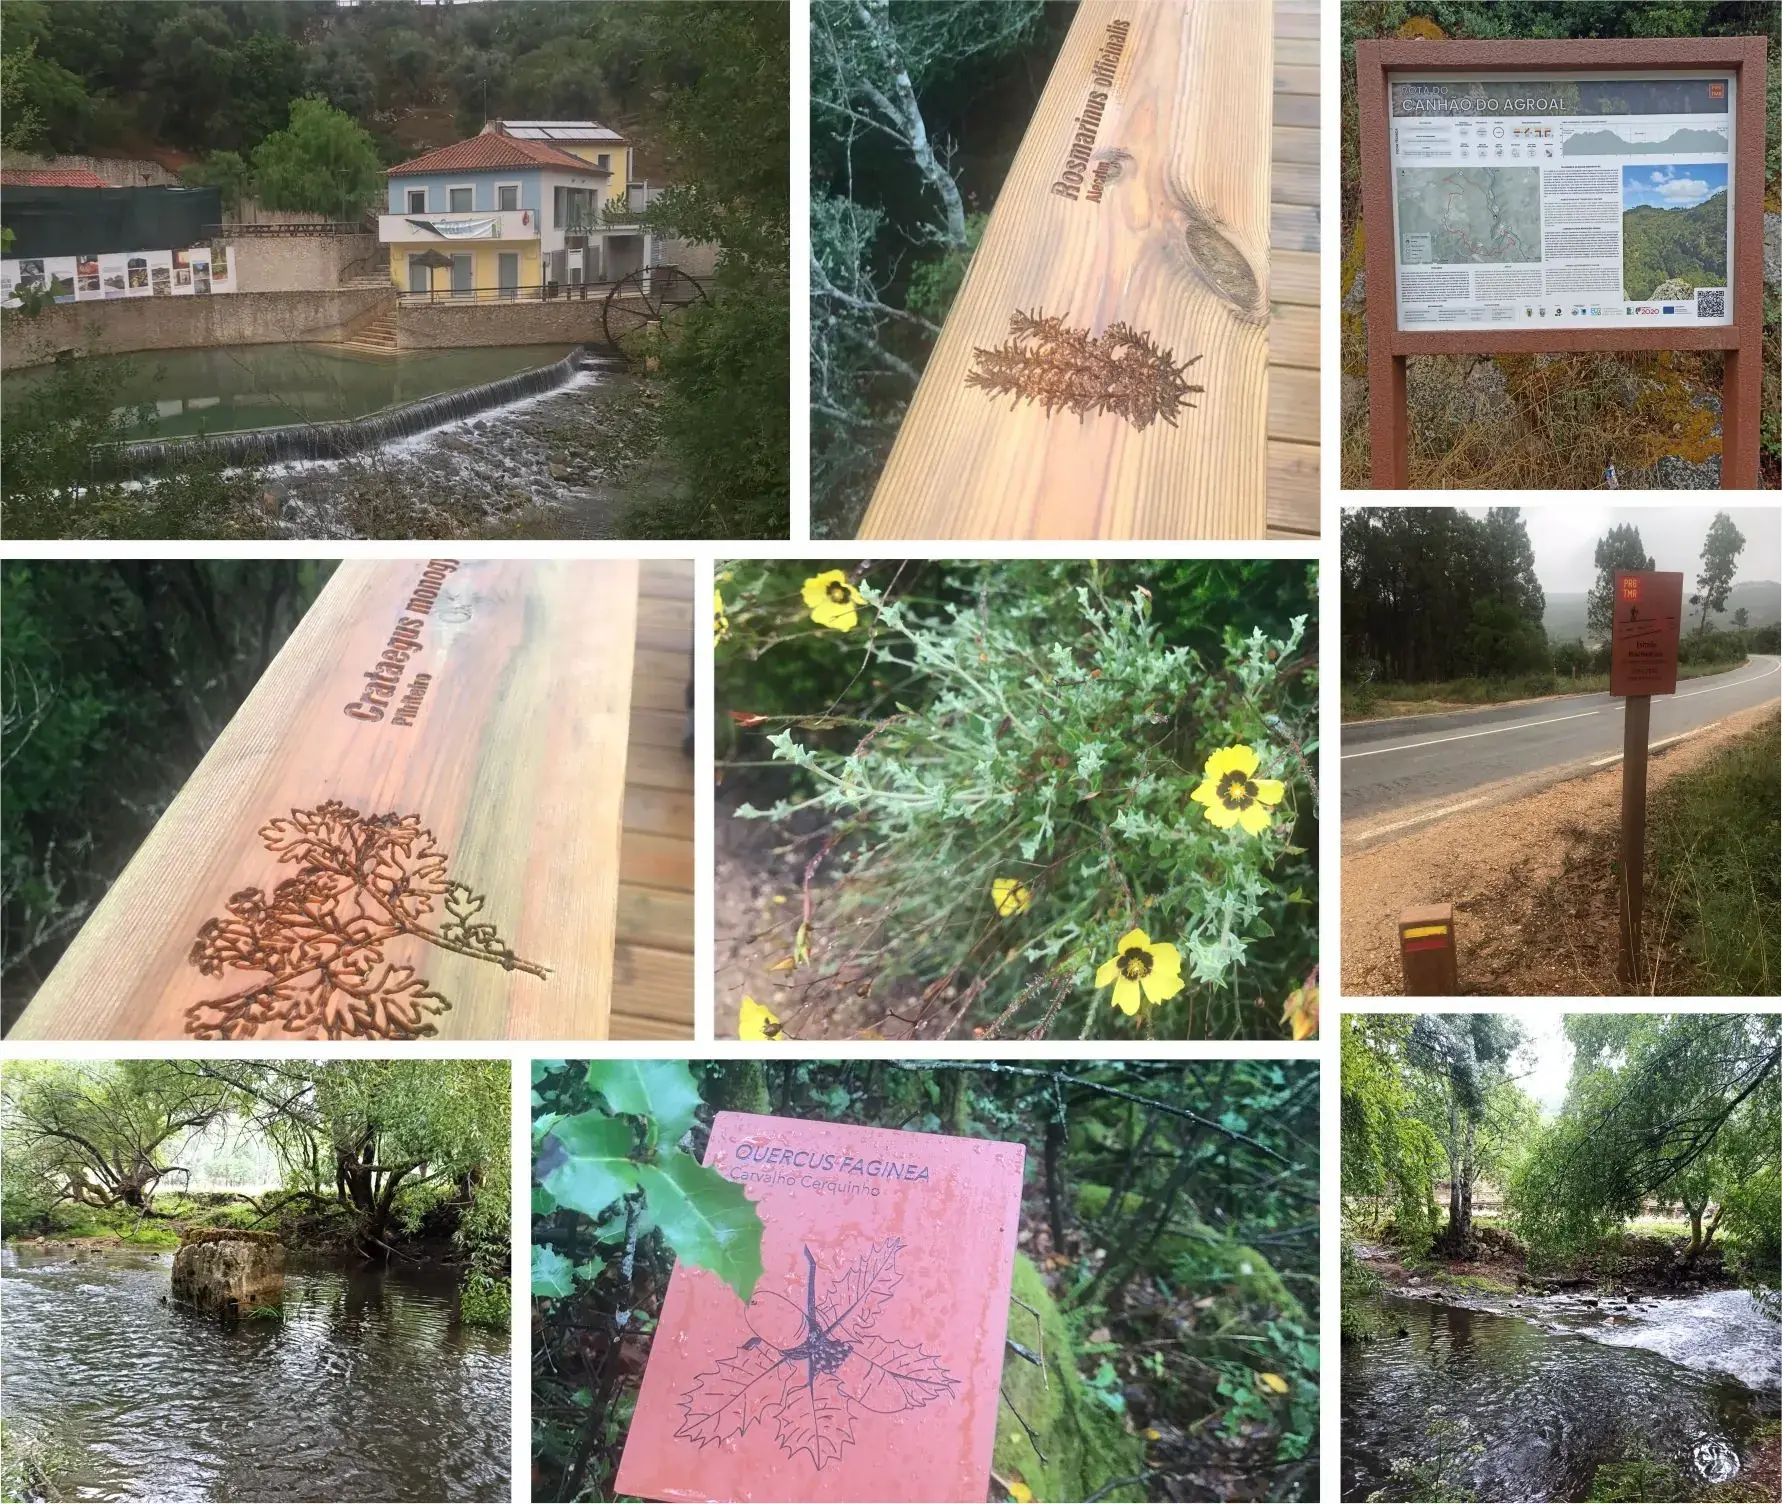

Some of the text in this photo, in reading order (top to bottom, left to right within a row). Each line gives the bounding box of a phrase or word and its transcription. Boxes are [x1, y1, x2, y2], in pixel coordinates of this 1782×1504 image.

[1401, 86, 1449, 95] ROTA DO
[1402, 96, 1567, 111] CANHÃO DO AGROAL
[1051, 19, 1131, 201] Rosmarinus officinalis
[1623, 588, 1637, 599] TMR
[344, 616, 424, 723] Crataegus
[735, 1143, 930, 1183] QUERCUS FAGINEA
[729, 1166, 881, 1197] Carvalho Cerquinho
